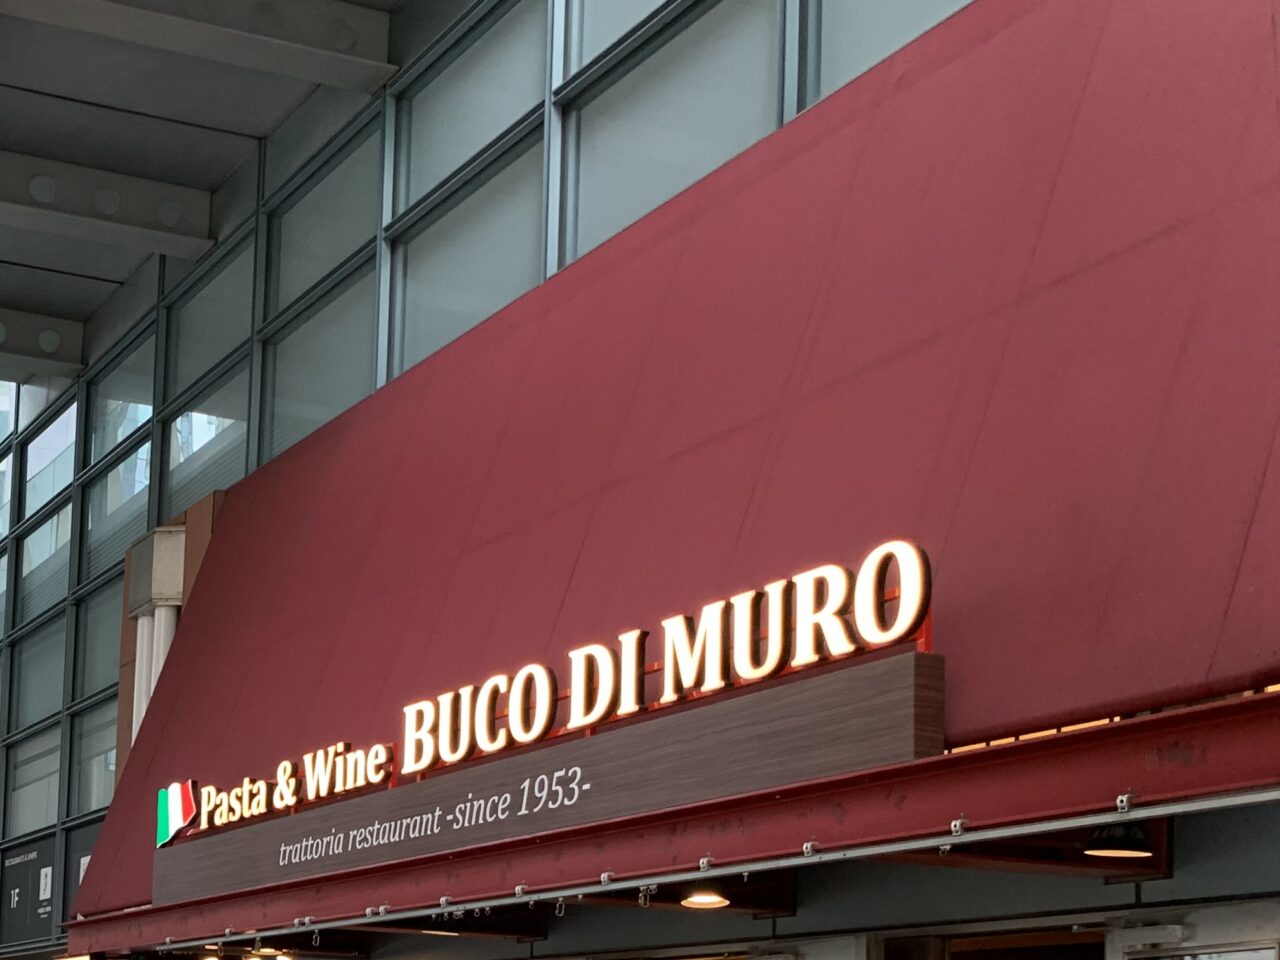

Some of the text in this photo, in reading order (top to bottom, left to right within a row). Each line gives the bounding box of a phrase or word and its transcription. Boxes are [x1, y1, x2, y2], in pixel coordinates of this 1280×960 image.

[199, 538, 927, 829] Pasta & Wine BUCO DI MURO
[278, 765, 591, 866] trattoria restaurant -since 1953-
[10, 888, 20, 909] 1F
